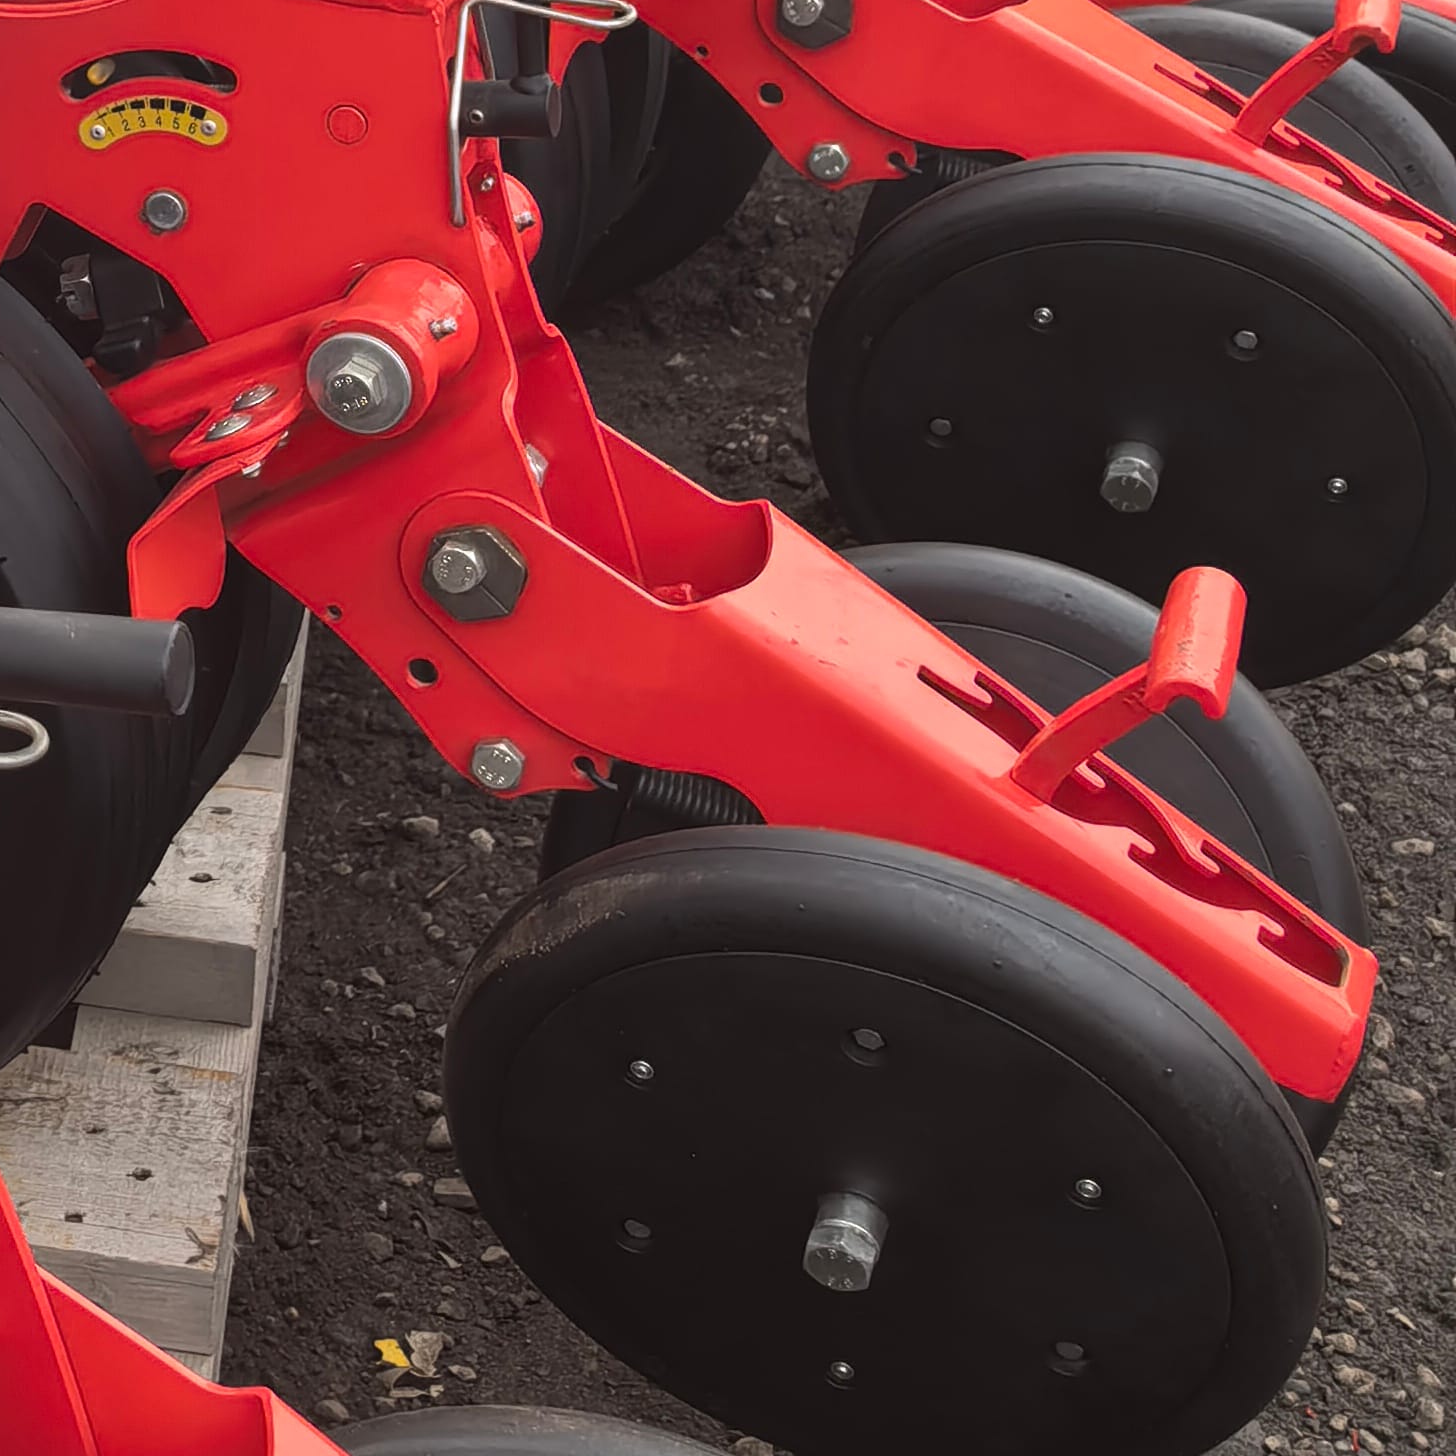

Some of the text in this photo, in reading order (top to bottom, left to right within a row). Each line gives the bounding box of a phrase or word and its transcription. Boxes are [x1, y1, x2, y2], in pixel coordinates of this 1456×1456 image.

[121, 119, 130, 131] 2
[138, 116, 146, 128] 3
[155, 116, 162, 127] 4
[172, 117, 180, 129] 5
[188, 122, 197, 135] 6
